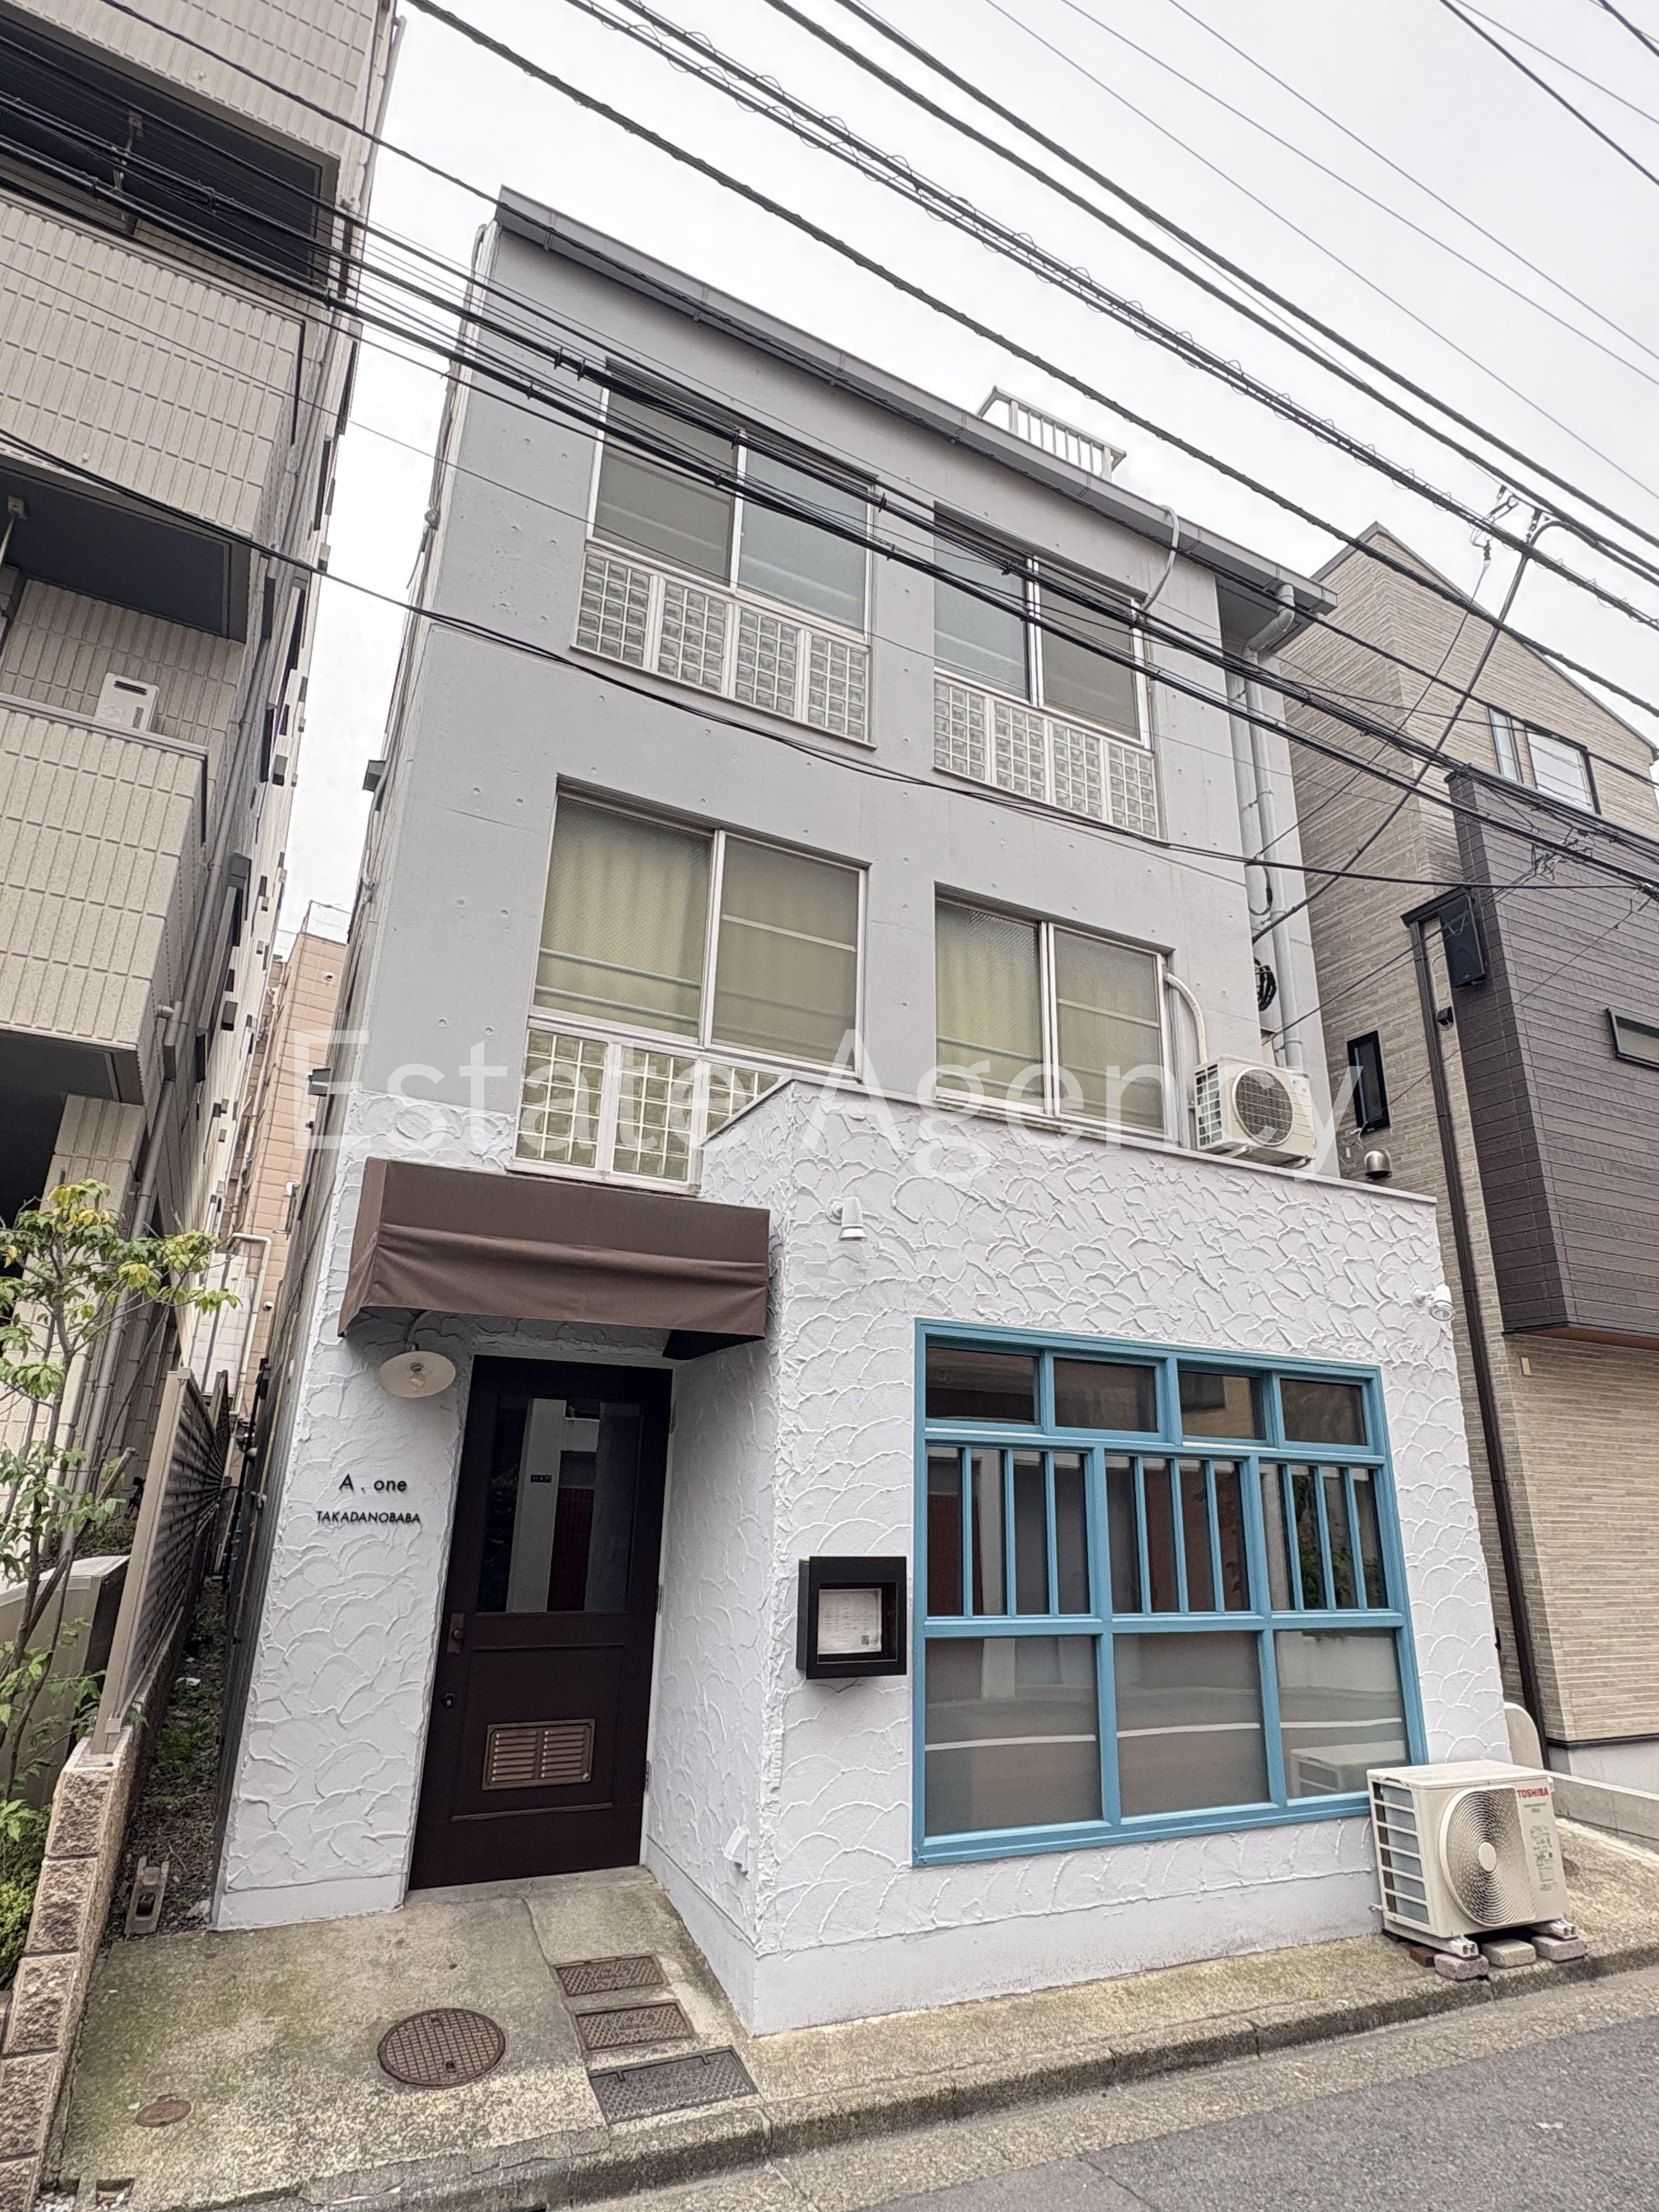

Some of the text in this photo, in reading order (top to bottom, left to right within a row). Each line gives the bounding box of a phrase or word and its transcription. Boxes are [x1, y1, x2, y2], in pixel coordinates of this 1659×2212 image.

[373, 1480, 408, 1492] one
[317, 1511, 421, 1524] TAKADANOBABA
[1516, 1787, 1549, 1798] TOSHIBA
